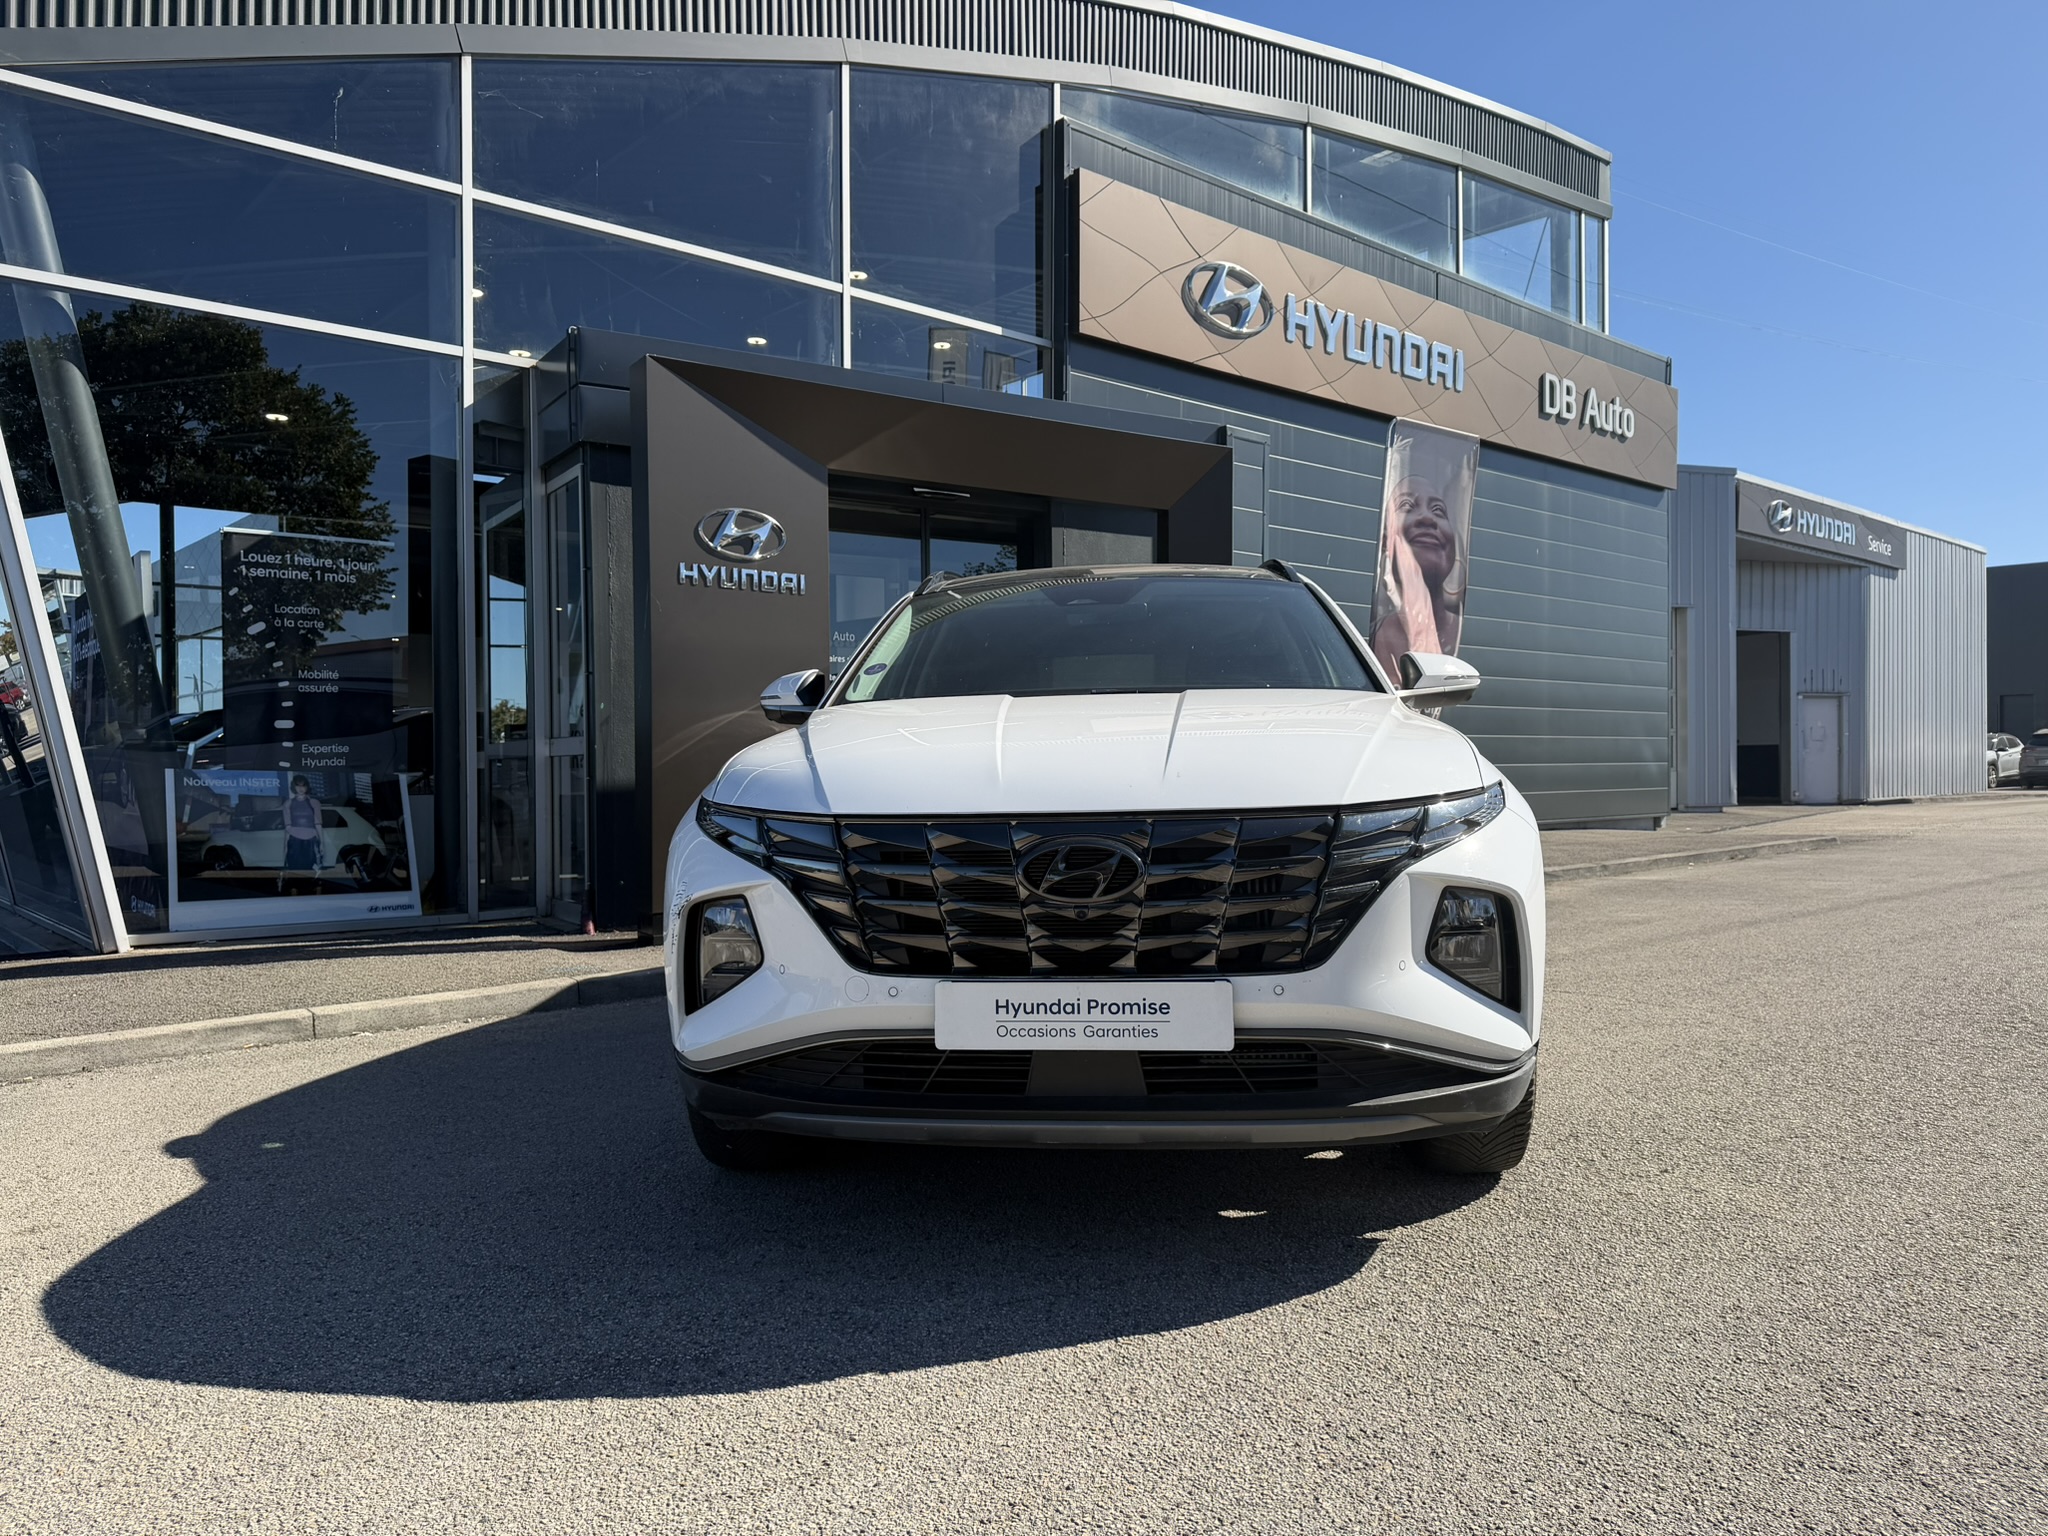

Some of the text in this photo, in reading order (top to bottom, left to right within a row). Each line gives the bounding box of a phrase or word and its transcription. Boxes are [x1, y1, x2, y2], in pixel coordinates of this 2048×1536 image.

[1284, 291, 1464, 392] HYUNDAI
[1539, 371, 1635, 441] DB Auto
[1797, 509, 1892, 556] HYUNDAI Service
[240, 550, 375, 573] Louez 1 heure, 1 jour,
[240, 565, 357, 584] 1 semaine, 1 mois
[678, 561, 806, 596] HYUNDAI
[274, 604, 320, 615] Location
[274, 618, 325, 629] à la carte
[832, 631, 856, 641] Auto
[298, 670, 340, 679] Mobilité
[298, 683, 339, 692] assurée
[302, 743, 350, 755] Expertise
[302, 757, 346, 768] Hyundai
[184, 776, 280, 787] Nouveau INSTER
[381, 904, 415, 912] HYUNDAI
[995, 998, 1171, 1018] Hyundai Promise
[996, 1024, 1158, 1038] Occasions Garanties
